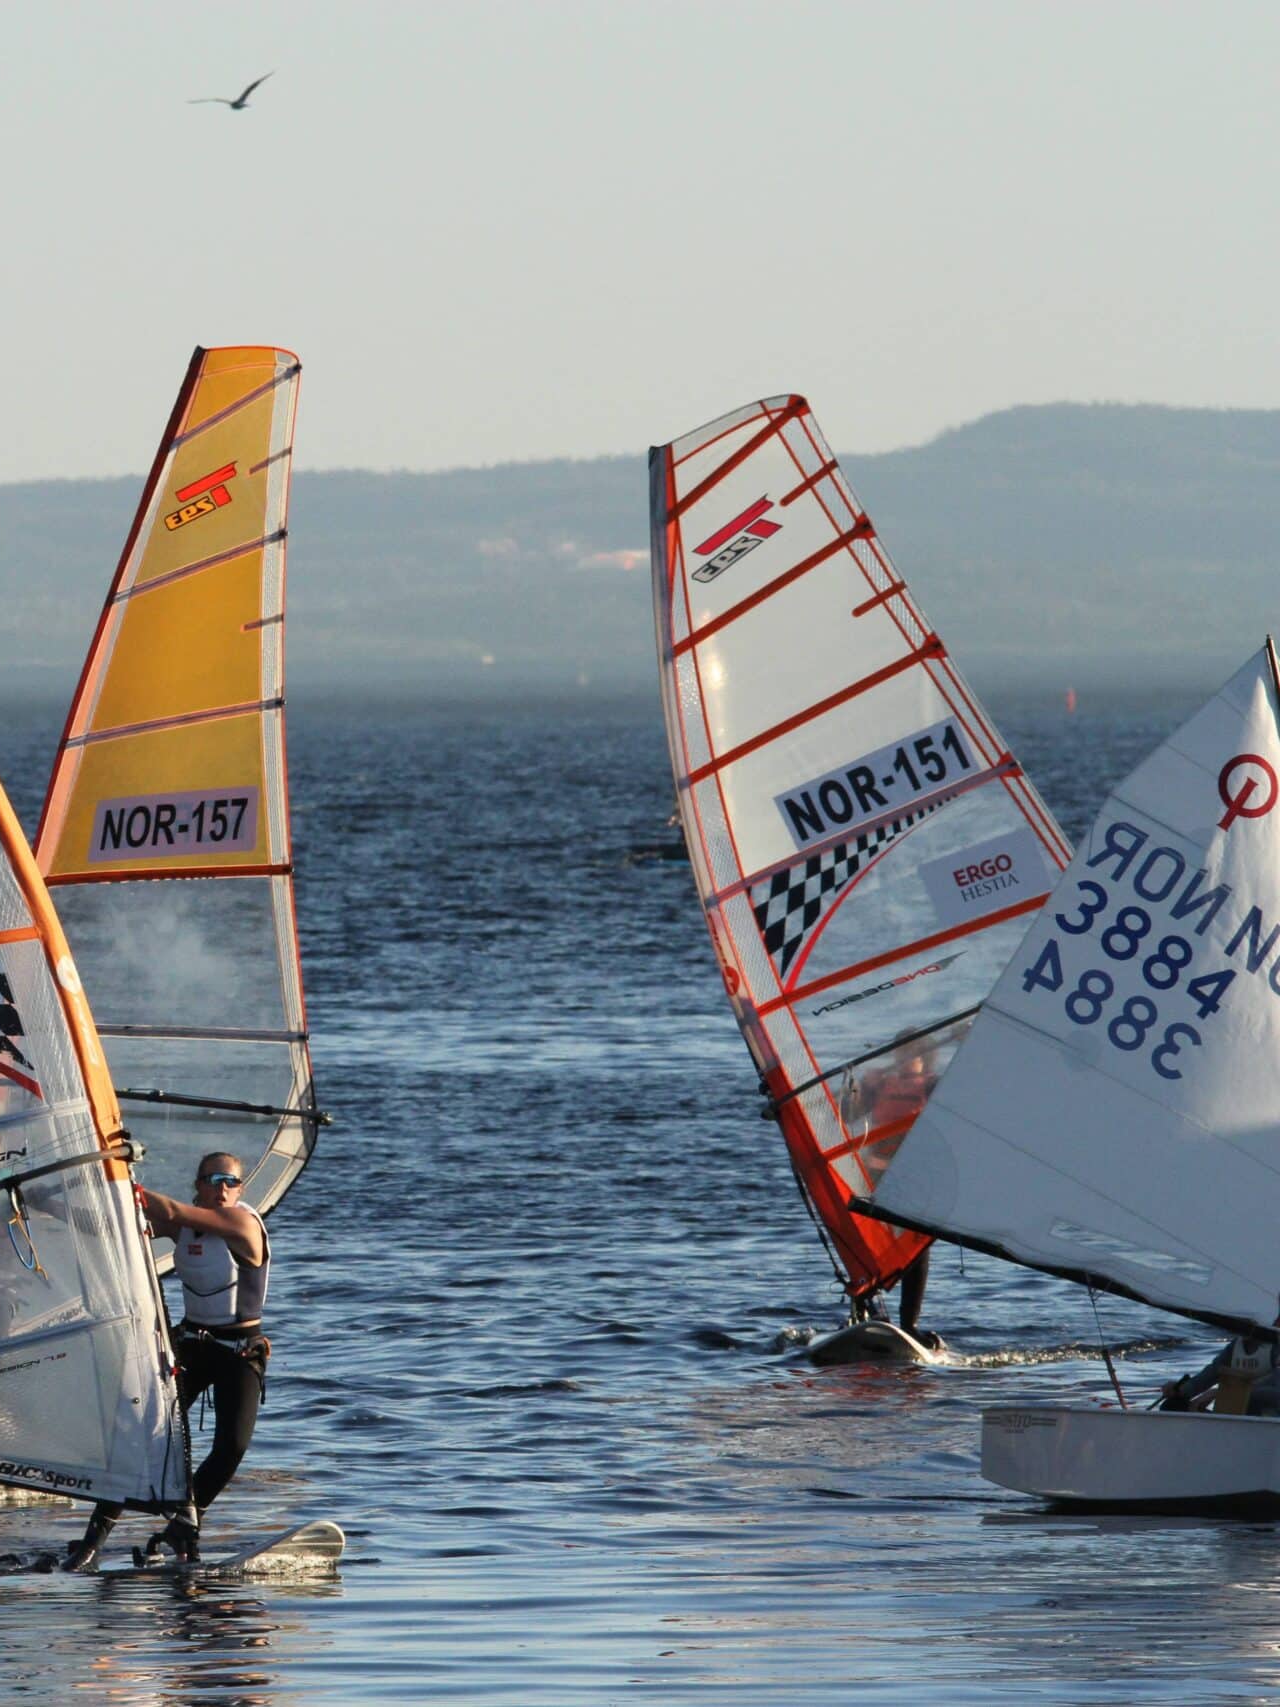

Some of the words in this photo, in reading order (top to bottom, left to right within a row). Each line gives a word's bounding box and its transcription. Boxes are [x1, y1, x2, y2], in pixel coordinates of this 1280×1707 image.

[784, 725, 970, 842] NOR-151
[100, 798, 248, 850] NOR-157
[953, 854, 1012, 887] ERGO
[960, 874, 1020, 903] HESTIA
[1055, 880, 1237, 1019] 3884
[45, 1470, 93, 1490] Sport
